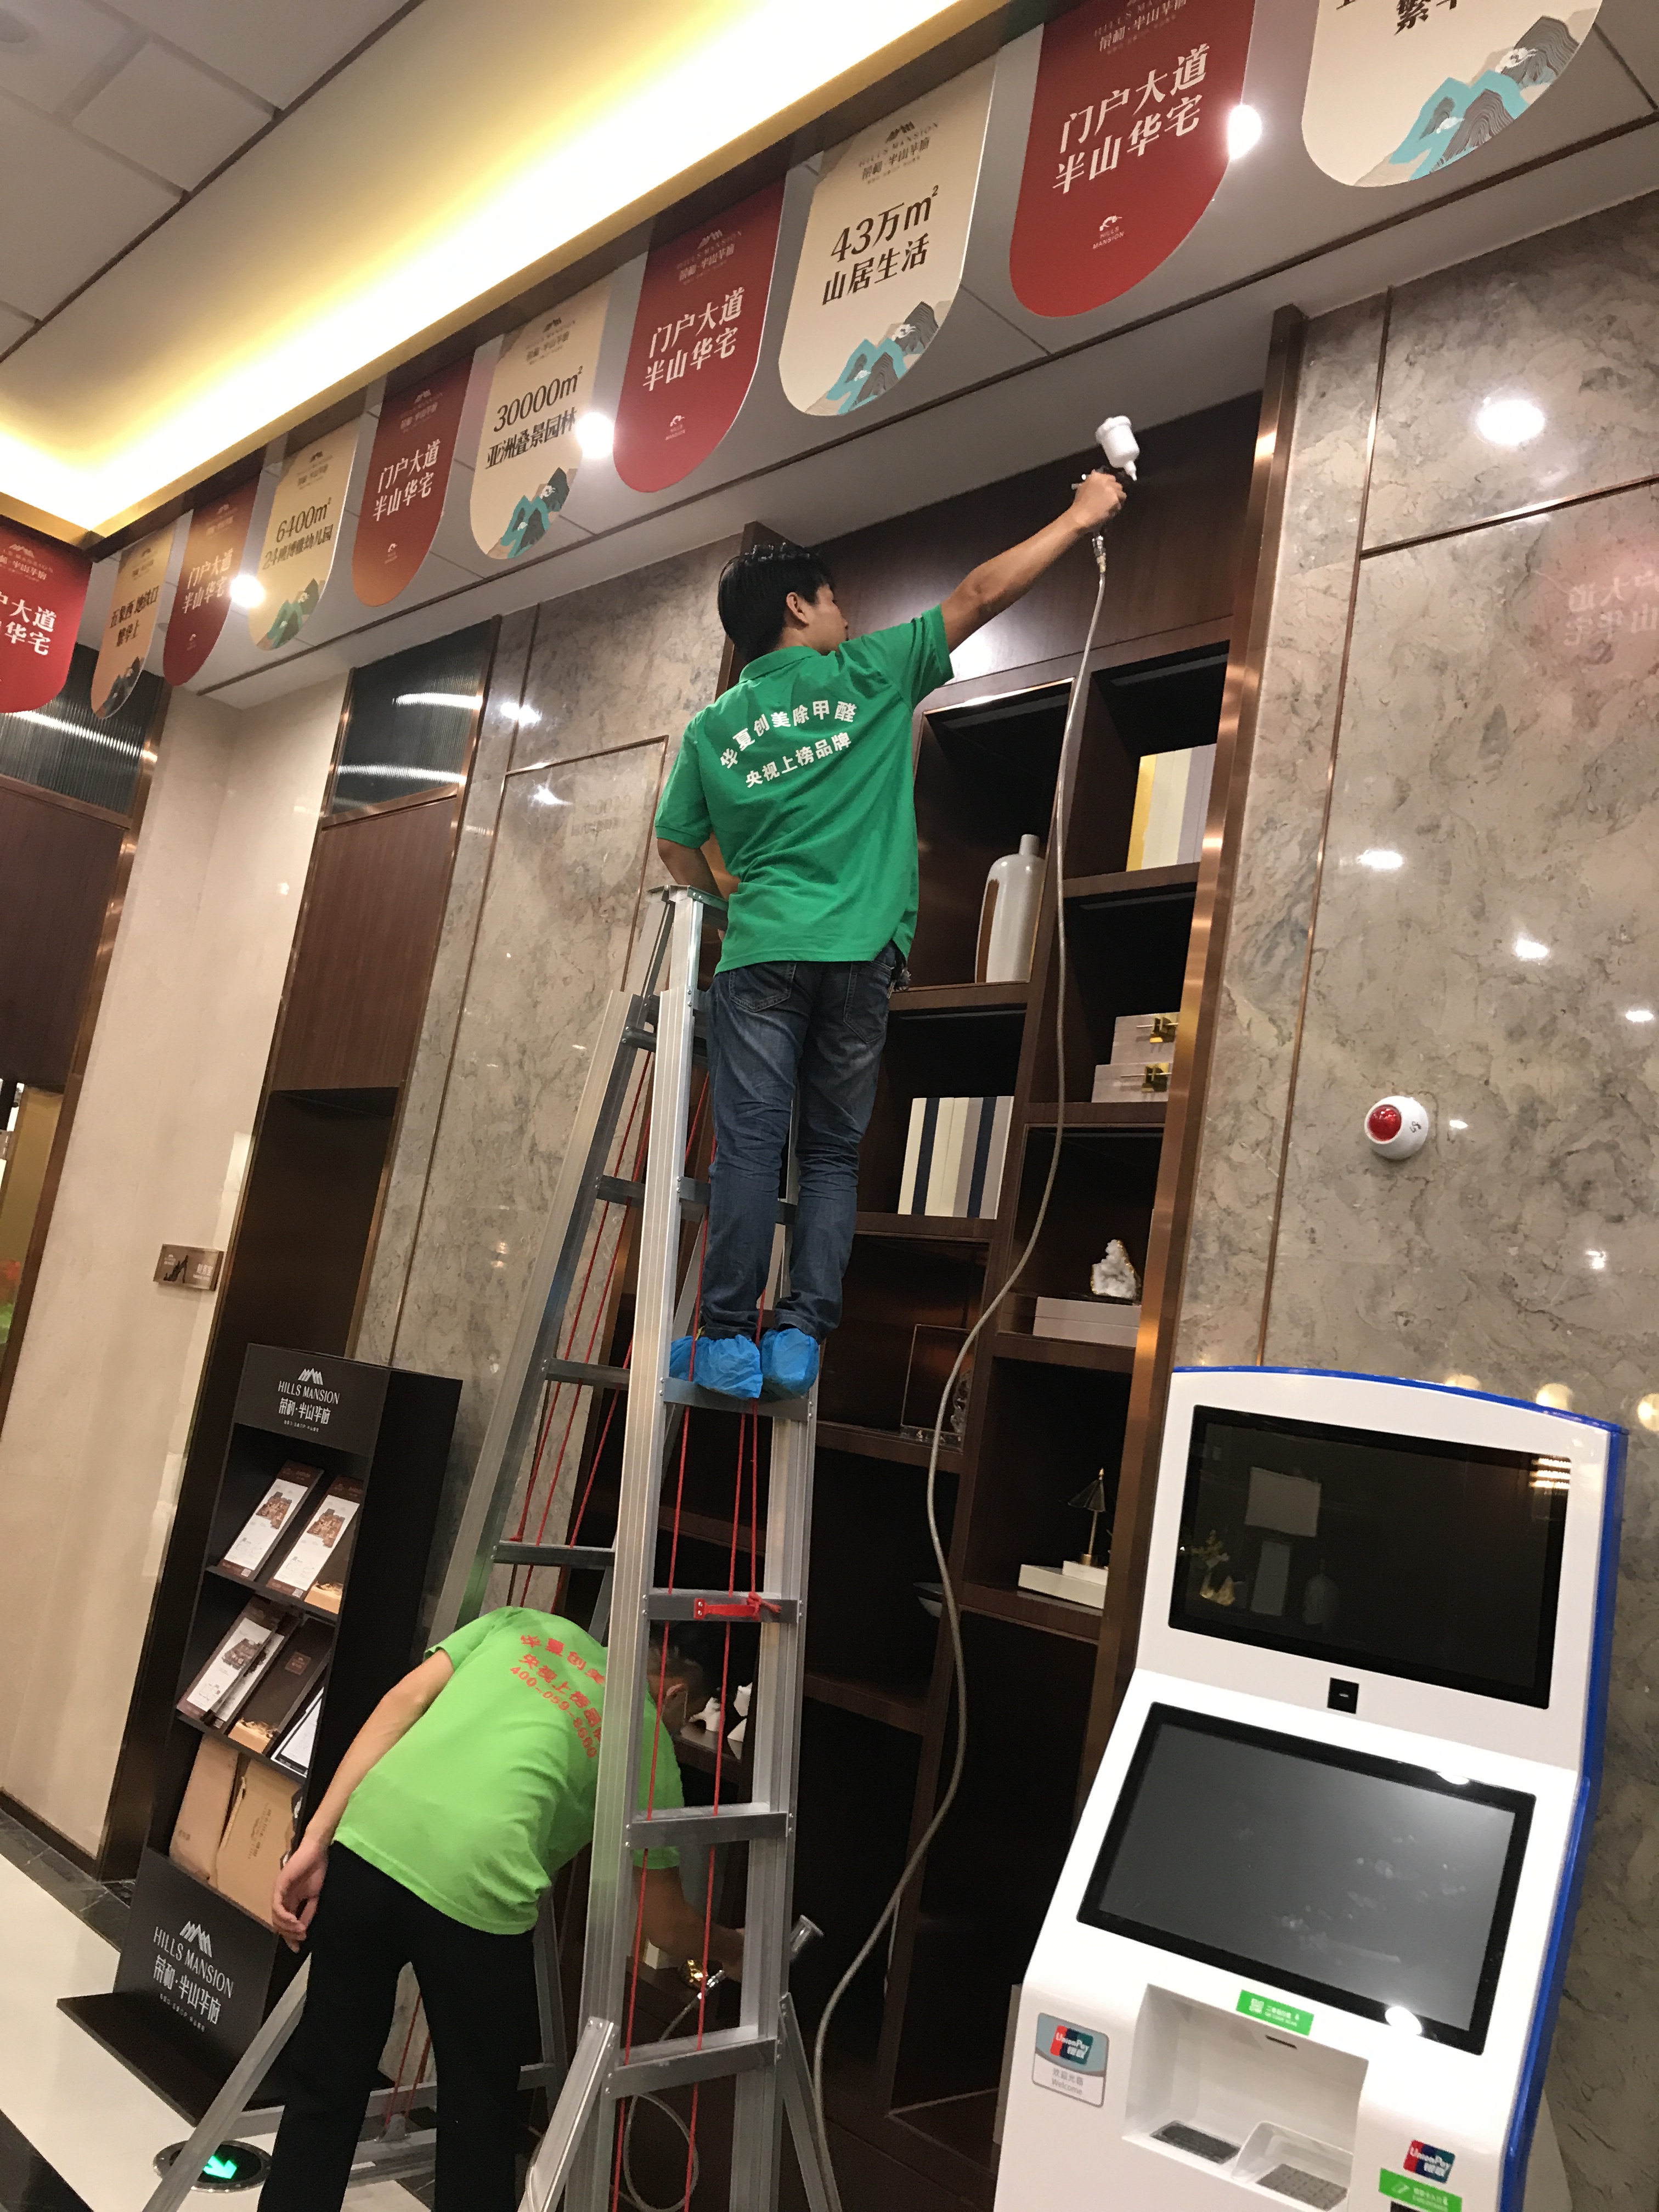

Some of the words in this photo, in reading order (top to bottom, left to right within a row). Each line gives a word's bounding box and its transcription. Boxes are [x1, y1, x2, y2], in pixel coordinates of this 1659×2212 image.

[1059, 43, 1210, 154] 门户大道
[1052, 94, 1203, 194] 半山华宅
[822, 233, 930, 306] 山居生活
[648, 286, 745, 358] 门户大道
[642, 326, 738, 392] 半山华宅
[377, 438, 441, 494] 门户大道
[485, 407, 577, 470] 亚洲叠景园林
[372, 472, 435, 522] 半山华宅
[182, 576, 228, 614] 半山华宅
[187, 548, 233, 589] 门户大道
[0, 621, 51, 656] 华宅
[720, 699, 857, 769] 华夏创美除甲醛
[746, 732, 852, 788] 央视上榜品牌
[278, 1380, 301, 1396] HILLS
[302, 1386, 340, 1405] MANSION
[153, 1926, 184, 1961] HILLS
[184, 1949, 234, 1999] MANSION
[1056, 2032, 1090, 2052] UnionPay
[1052, 2077, 1083, 2096] Welcome
